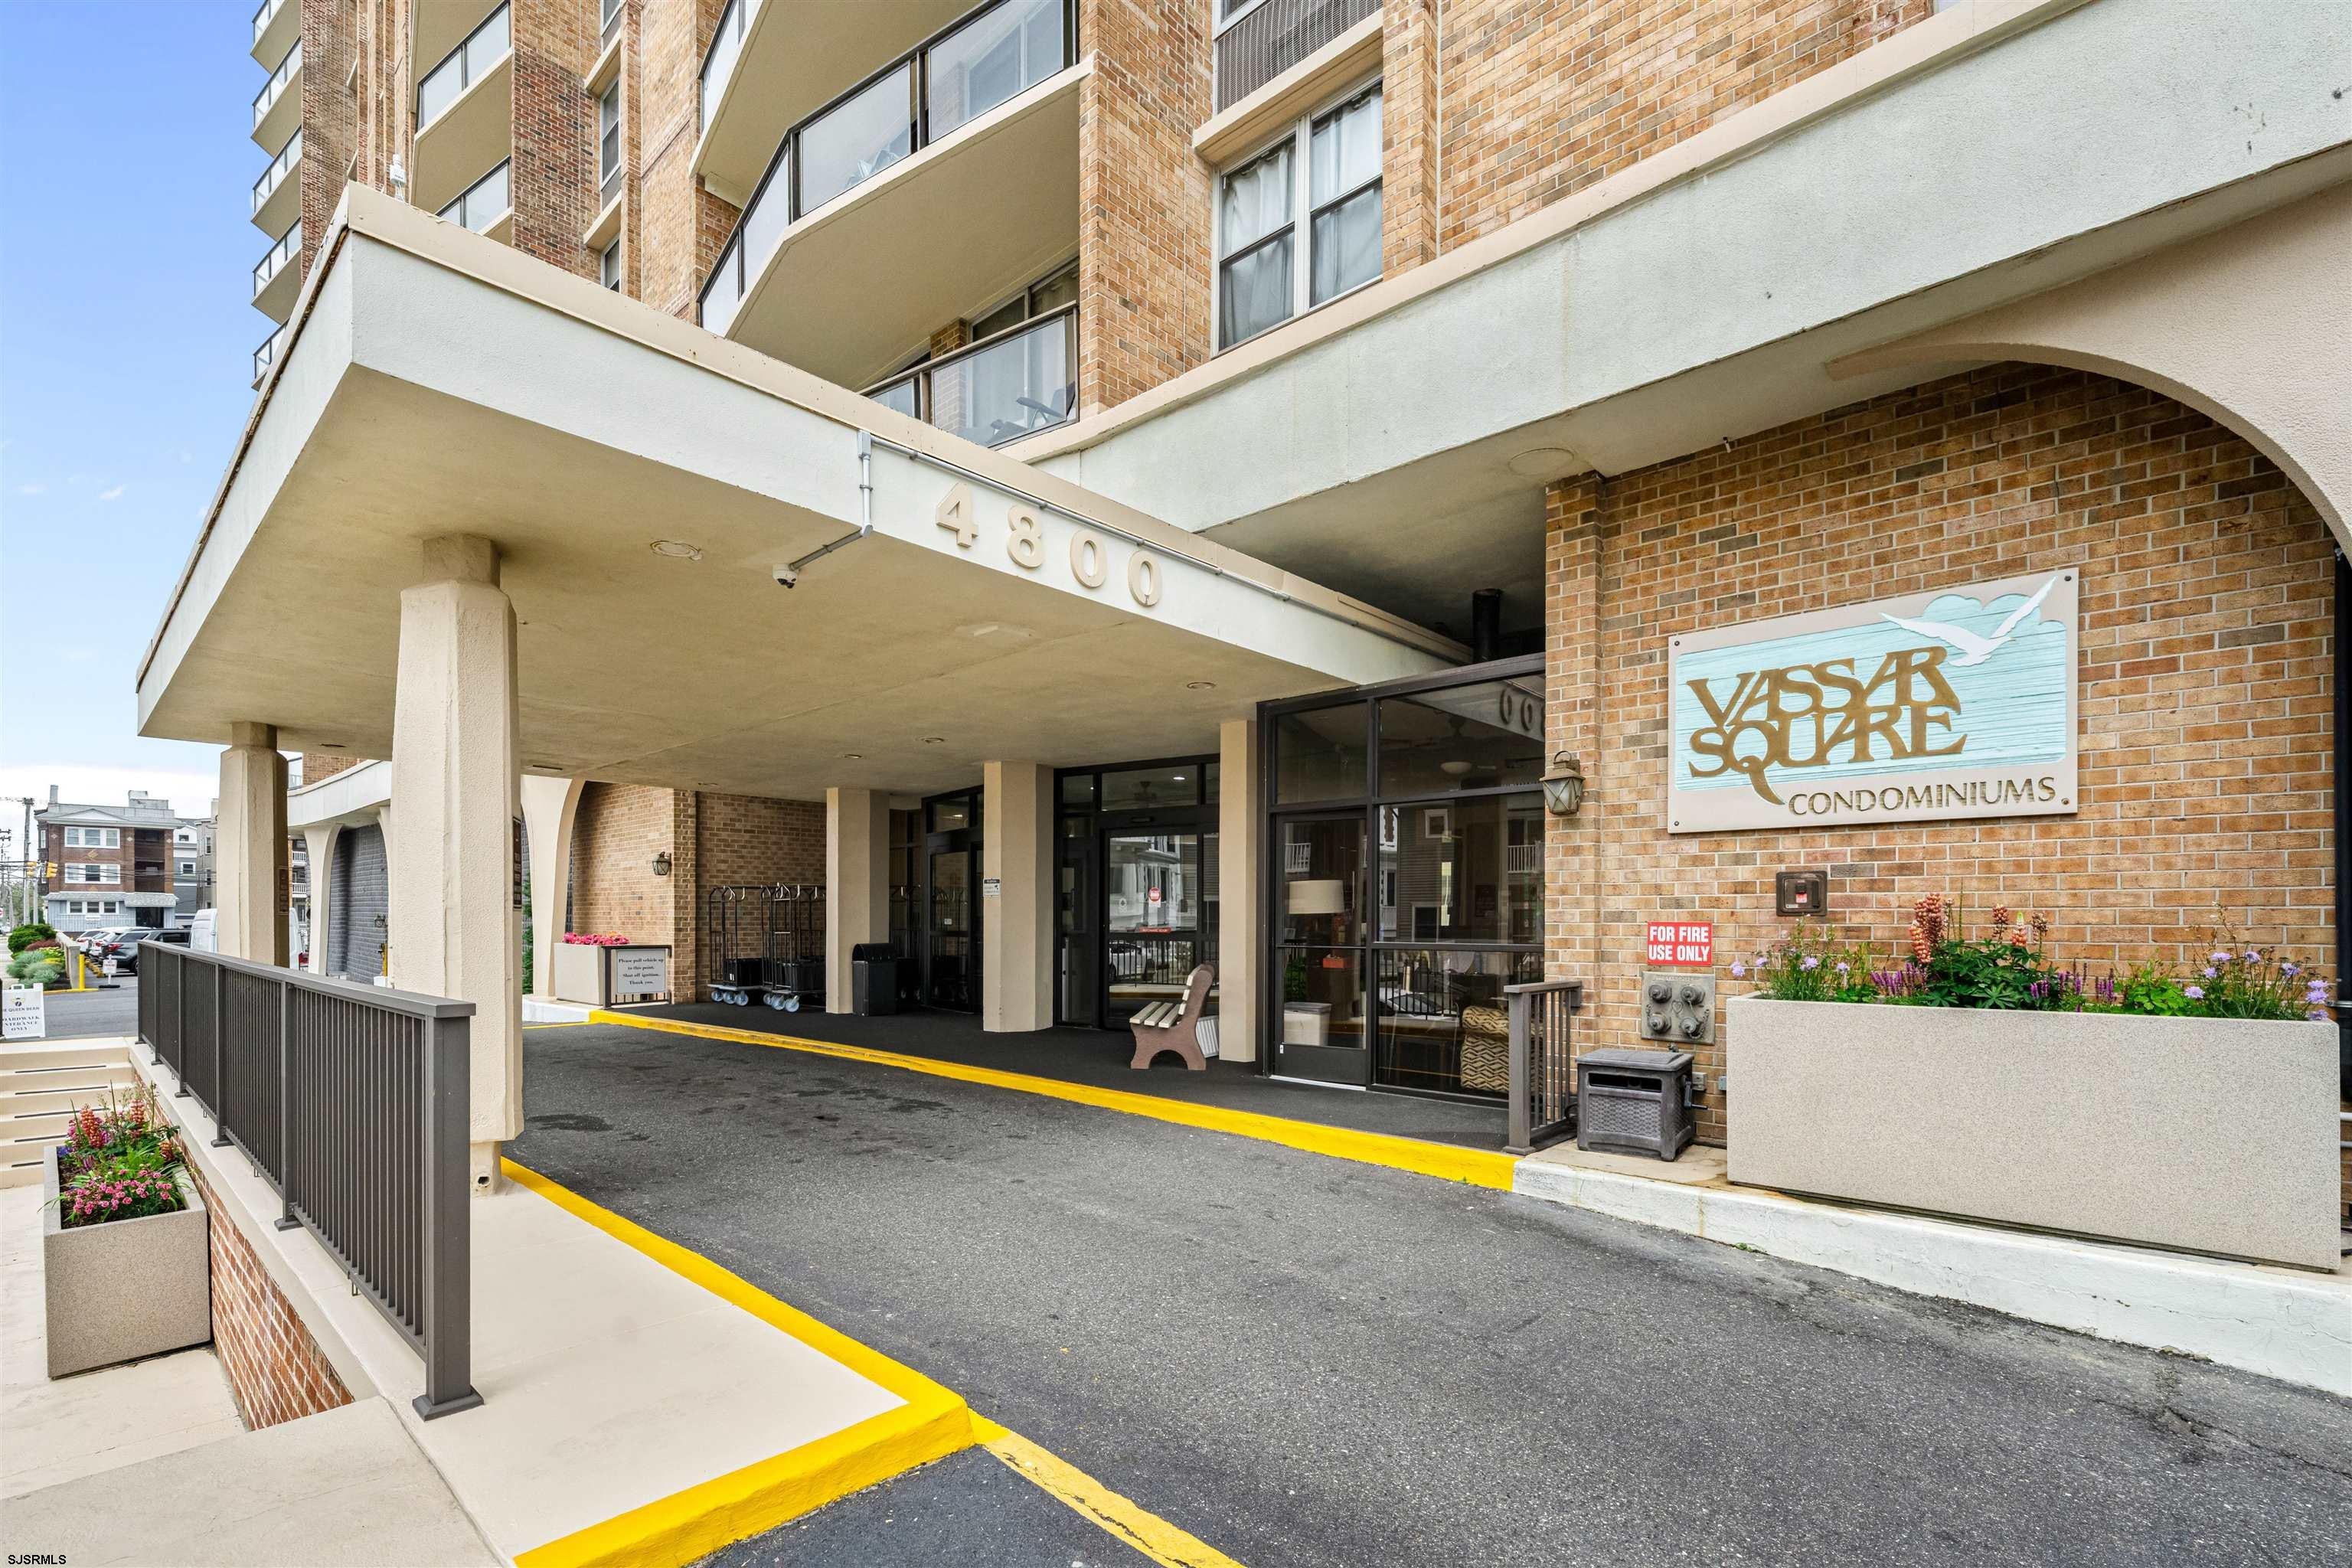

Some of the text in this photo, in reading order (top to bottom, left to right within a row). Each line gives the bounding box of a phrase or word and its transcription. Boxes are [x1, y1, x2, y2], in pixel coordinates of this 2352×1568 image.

[935, 482, 1162, 607] 4800
[1686, 645, 1962, 728] VASSAR
[1688, 704, 1968, 805] SQUARE
[1788, 776, 2056, 816] CONDOMINIUMS
[1648, 944, 1710, 962] USE ONLY
[1649, 926, 1709, 942] FOR FIRE
